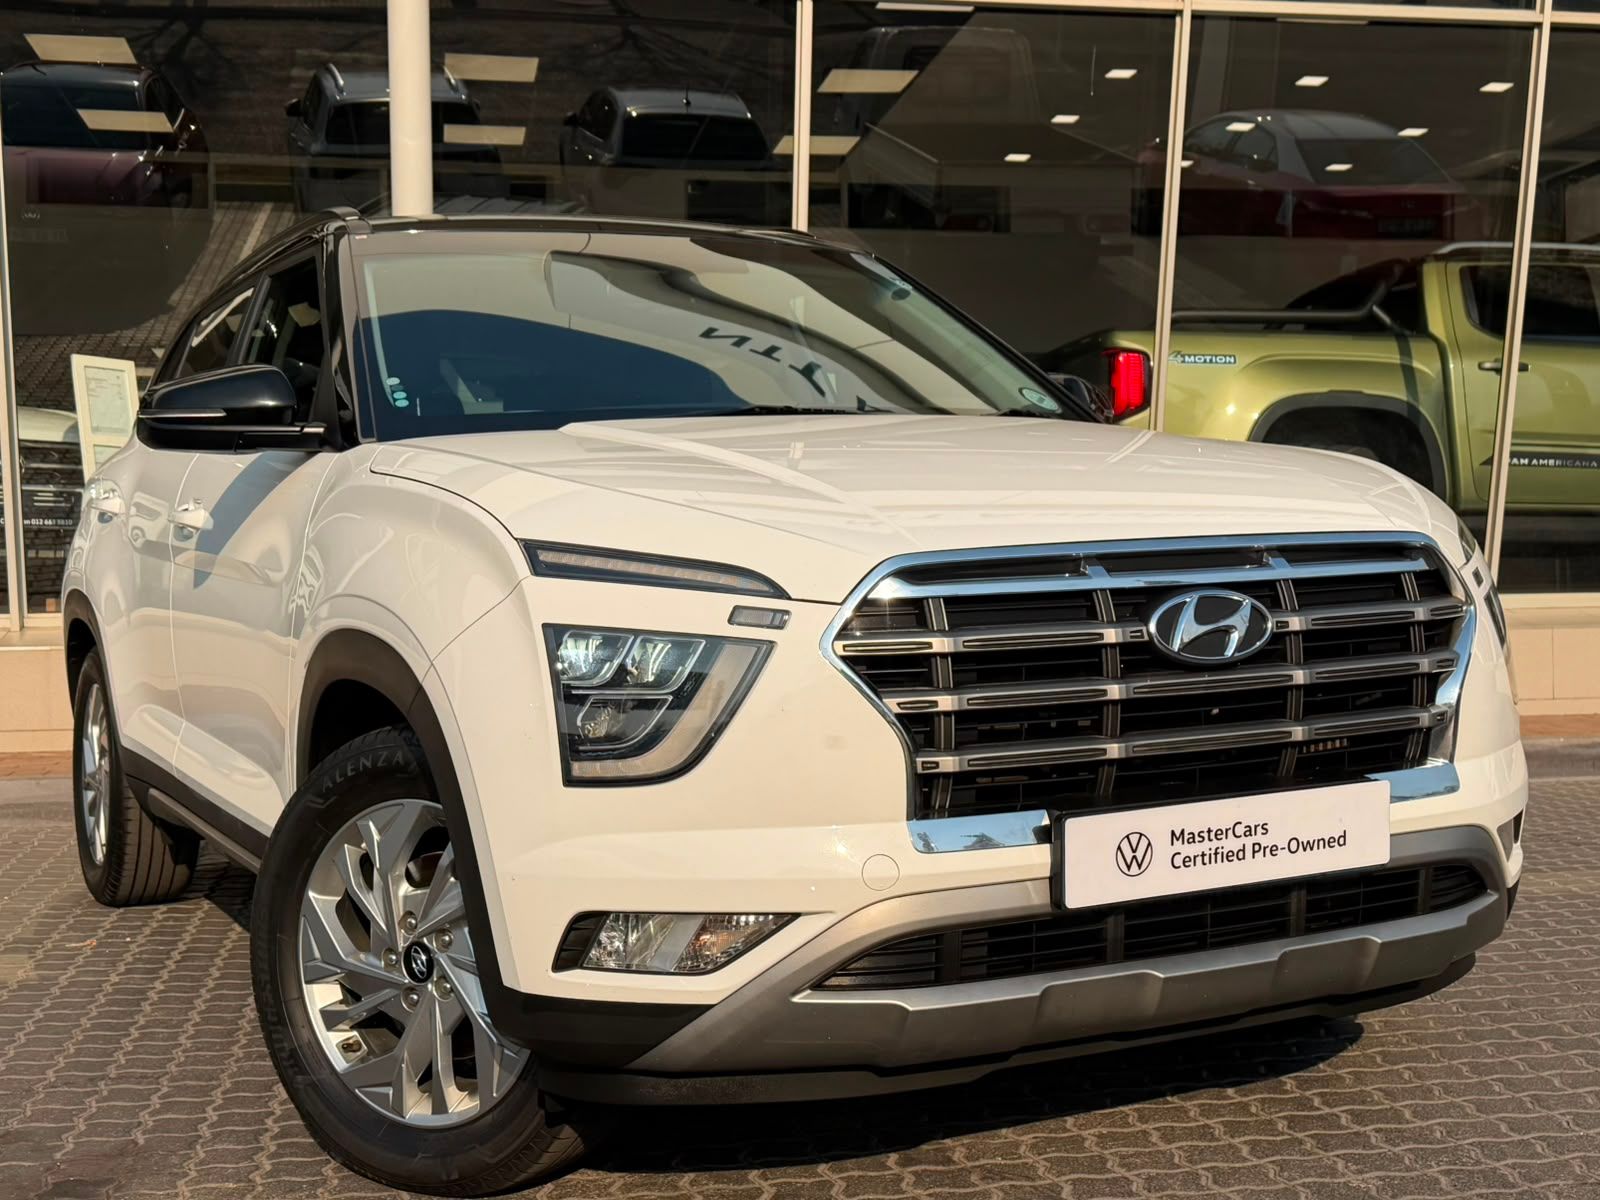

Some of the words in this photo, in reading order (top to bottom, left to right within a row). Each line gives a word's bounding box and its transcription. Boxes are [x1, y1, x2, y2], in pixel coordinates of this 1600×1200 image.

[1531, 458, 1598, 468] AMERICANA
[321, 751, 404, 793] ALENZA
[1170, 821, 1269, 847] MasterCars
[1170, 843, 1246, 870] Certified
[1251, 829, 1347, 860] Pre-Owned
